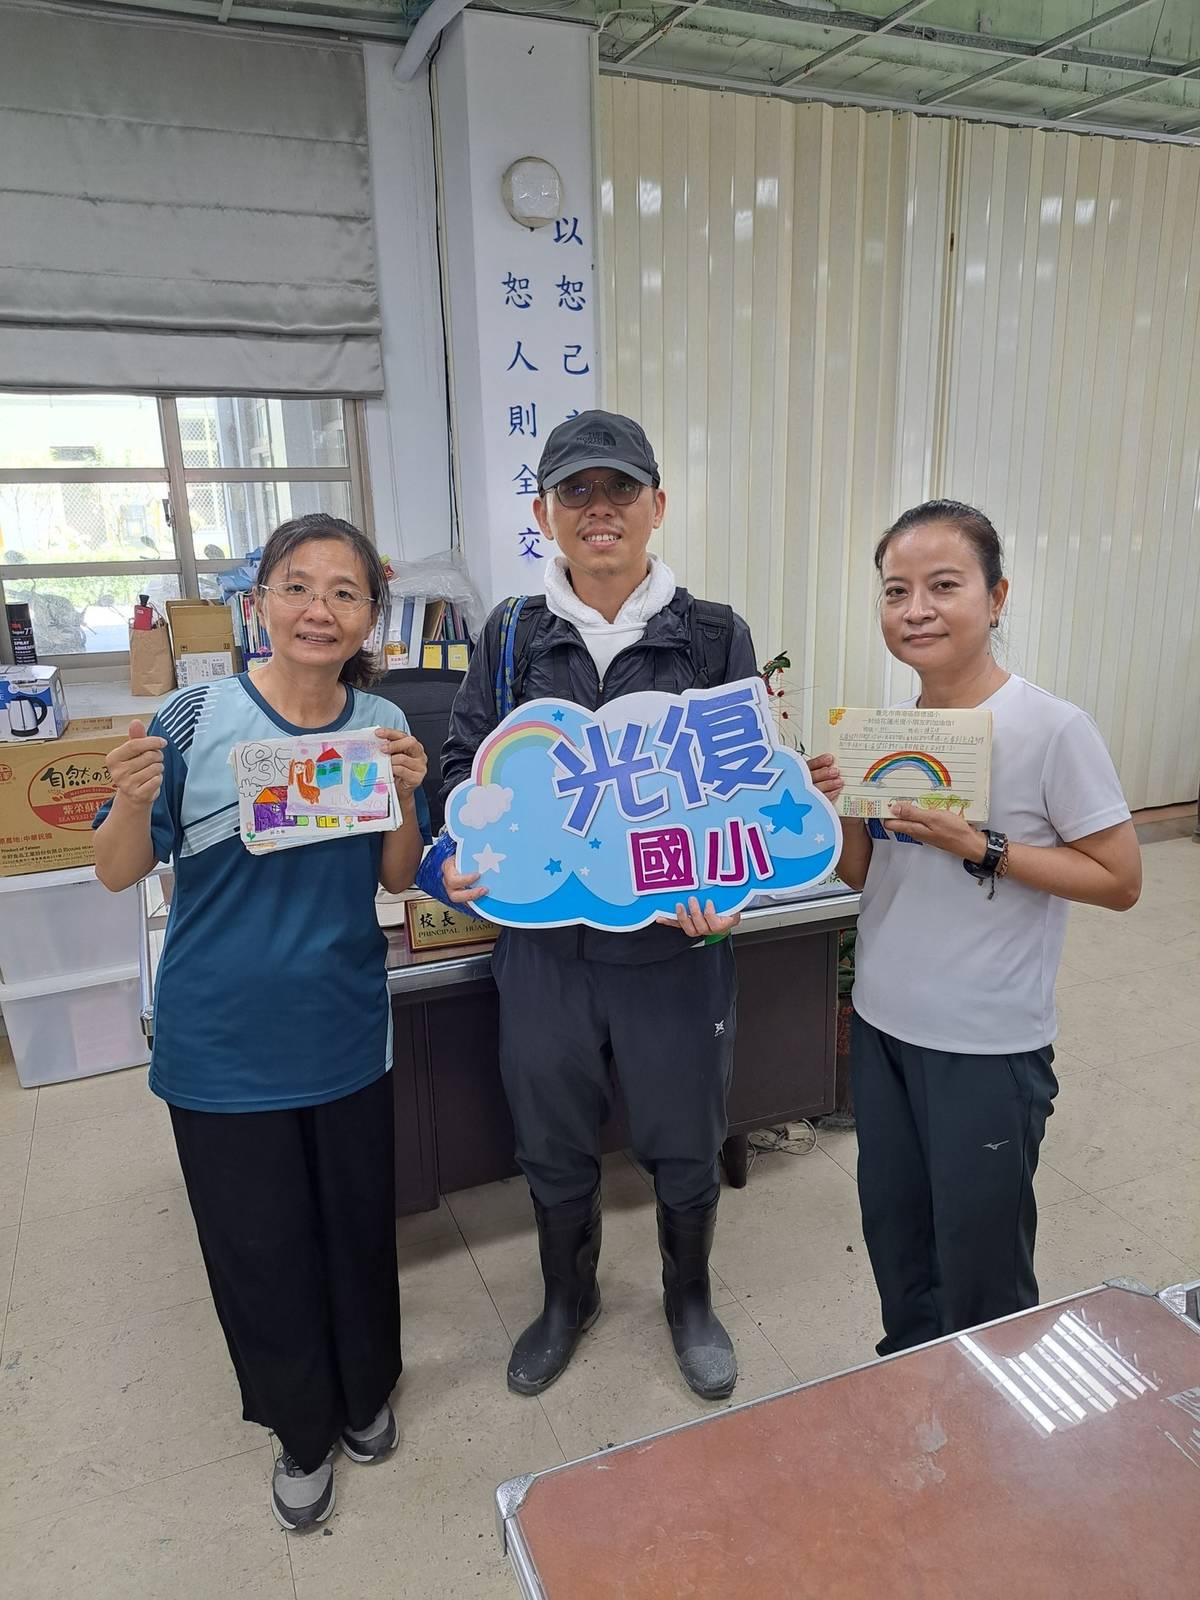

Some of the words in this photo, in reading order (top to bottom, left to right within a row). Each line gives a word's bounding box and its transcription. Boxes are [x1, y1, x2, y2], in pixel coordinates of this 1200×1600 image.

[553, 217, 590, 420] 以恕己
[501, 271, 544, 559] 恕人則全交
[551, 687, 781, 833] 光復
[630, 820, 771, 893] 國小
[417, 926, 460, 938] PRINCIPAL
[465, 923, 495, 932] HUANG
[420, 910, 456, 929] 校長
